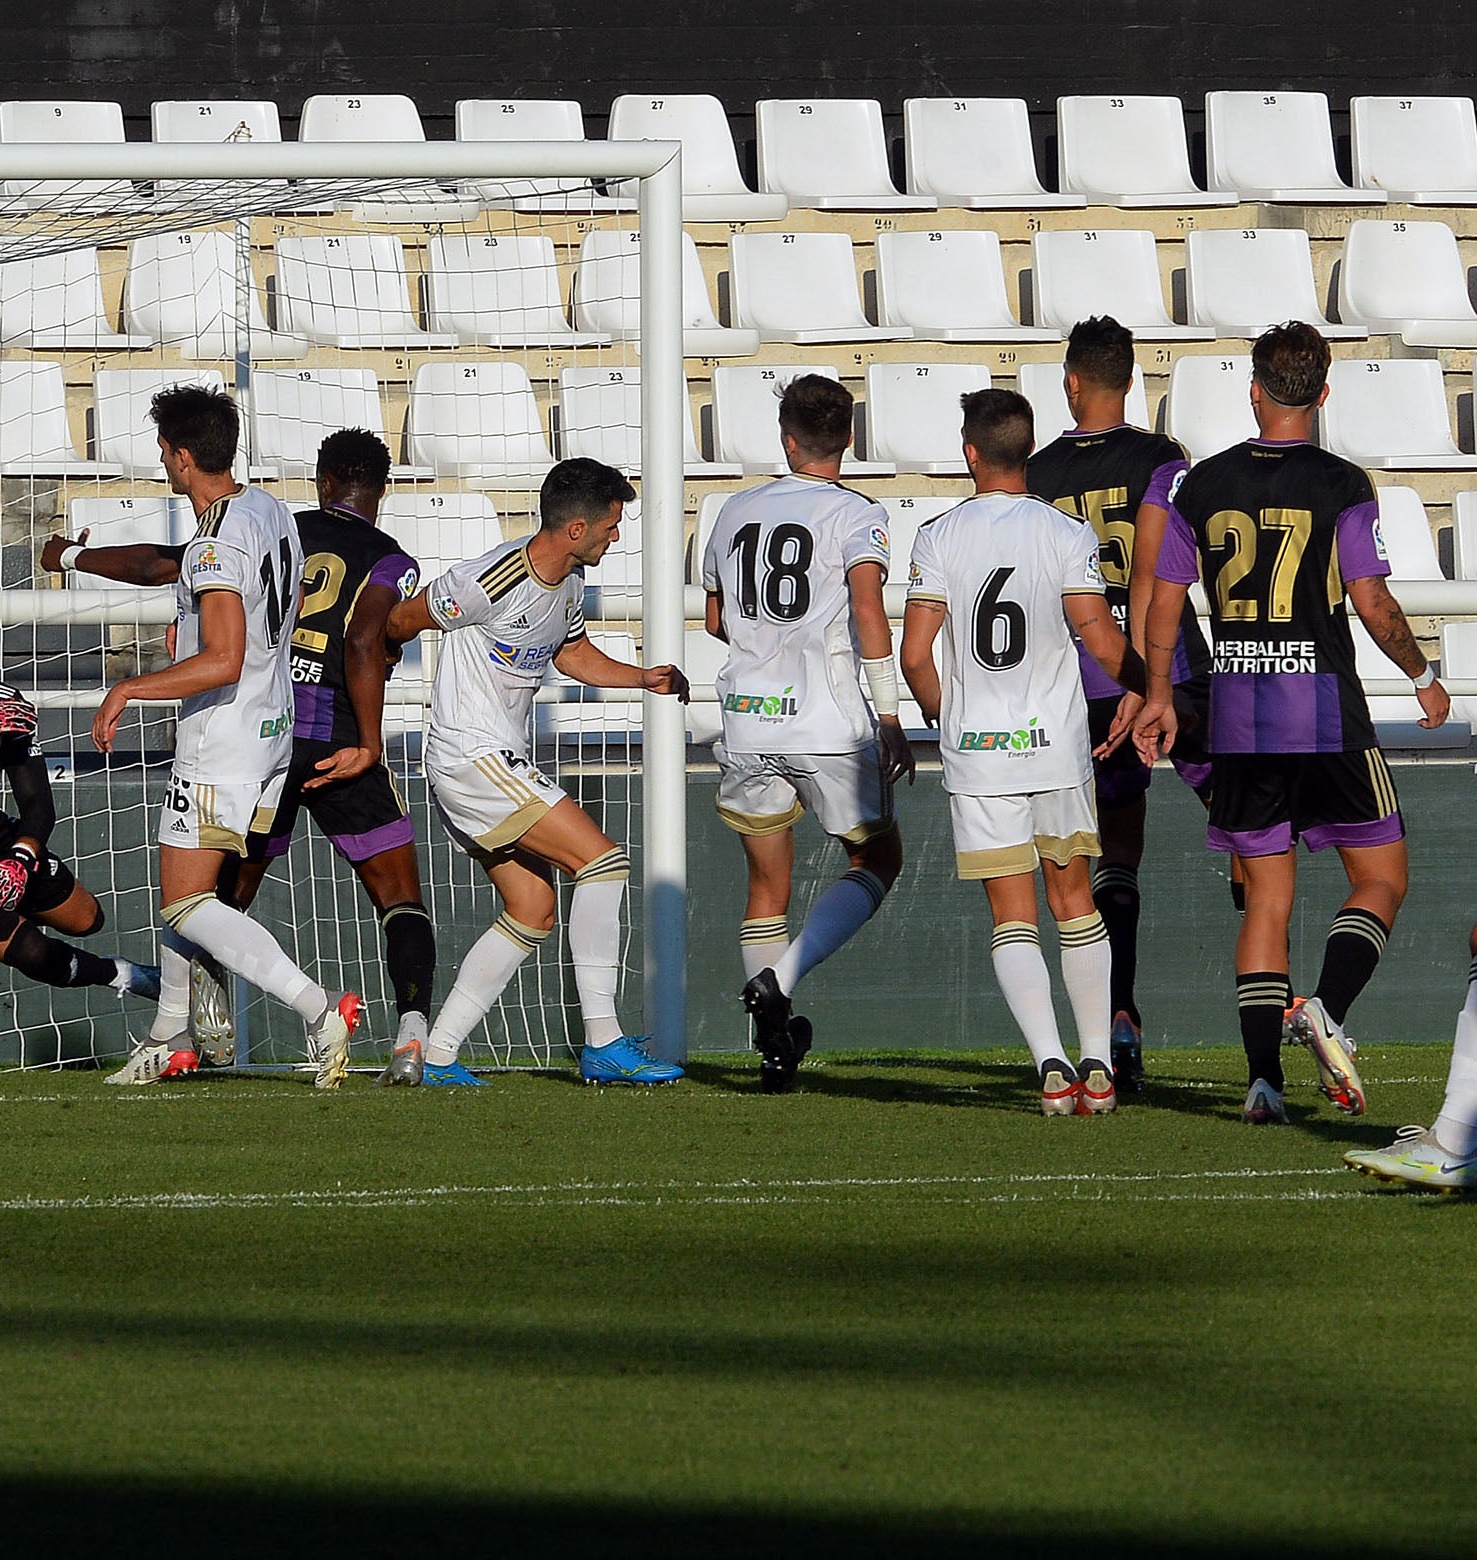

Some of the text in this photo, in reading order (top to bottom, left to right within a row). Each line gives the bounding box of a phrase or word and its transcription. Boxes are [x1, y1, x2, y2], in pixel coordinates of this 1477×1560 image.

[347, 99, 361, 109] 23
[651, 100, 664, 110] 27
[1110, 99, 1124, 108] 33
[1263, 96, 1277, 105] 35
[1399, 101, 1412, 110] 37
[198, 106, 212, 116] 21
[500, 104, 515, 114] 25
[798, 105, 813, 115] 29
[953, 101, 967, 111] 31
[54, 108, 62, 117] 9
[1393, 222, 1406, 232] 35
[177, 234, 192, 244] 19
[782, 234, 795, 244] 27
[928, 232, 942, 242] 29
[1083, 232, 1097, 241] 31
[1242, 230, 1257, 240] 33
[326, 238, 340, 248] 21
[483, 237, 498, 247] 23
[1220, 361, 1234, 371] 31
[1366, 363, 1381, 373] 33
[298, 371, 313, 381] 19
[463, 368, 477, 378] 21
[609, 372, 623, 382] 23
[761, 370, 776, 380] 25
[915, 367, 929, 377] 27
[119, 499, 133, 509] 15
[430, 497, 444, 507] 19
[899, 498, 914, 508] 25
[1206, 508, 1313, 622] 27
[727, 522, 814, 626] 18
[971, 566, 1028, 671] 6
[1214, 640, 1316, 657] HERBALIFE
[1212, 657, 1317, 674] NUTRITION
[958, 728, 1051, 751] BEROIL
[54, 764, 66, 780] 2
